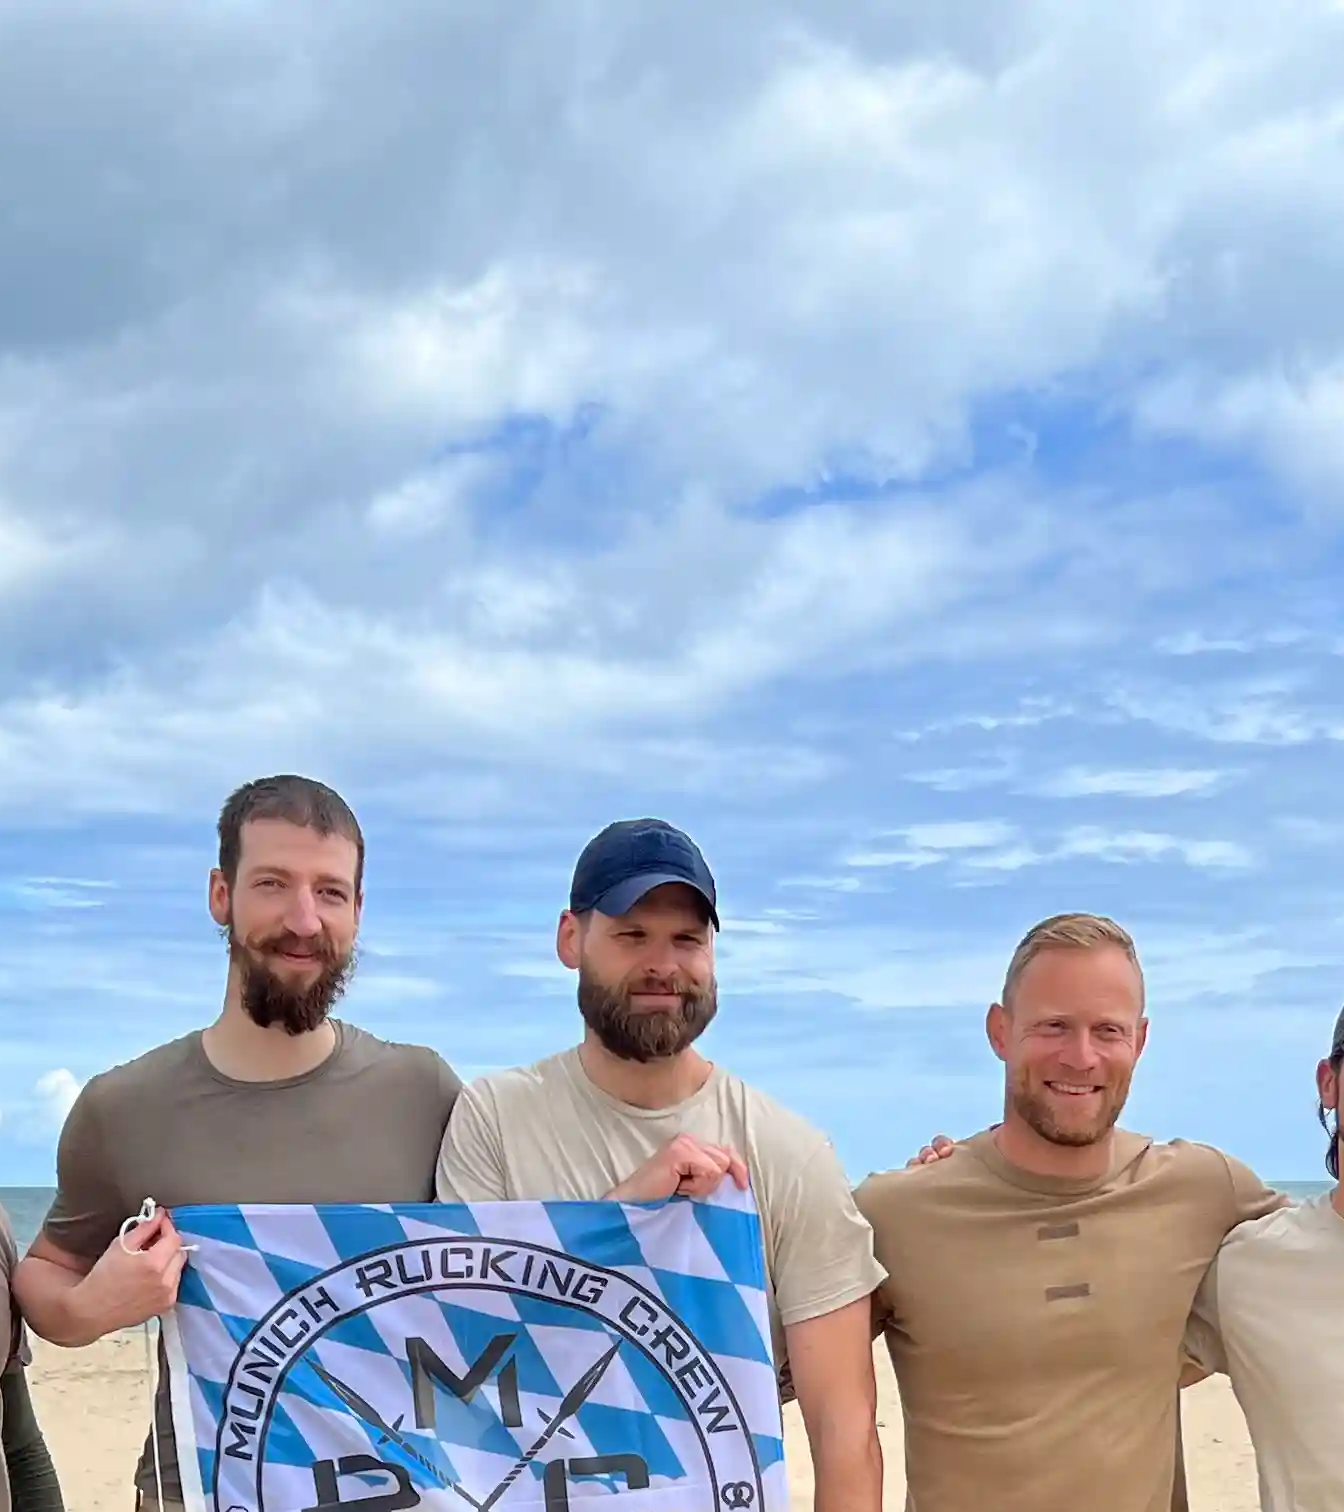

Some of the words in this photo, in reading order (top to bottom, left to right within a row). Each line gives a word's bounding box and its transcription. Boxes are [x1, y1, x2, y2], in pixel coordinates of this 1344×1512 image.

[224, 1285, 341, 1462] MUNICH
[355, 1246, 609, 1304] RUCKING
[618, 1295, 739, 1434] CREW
[404, 1332, 520, 1430] M
